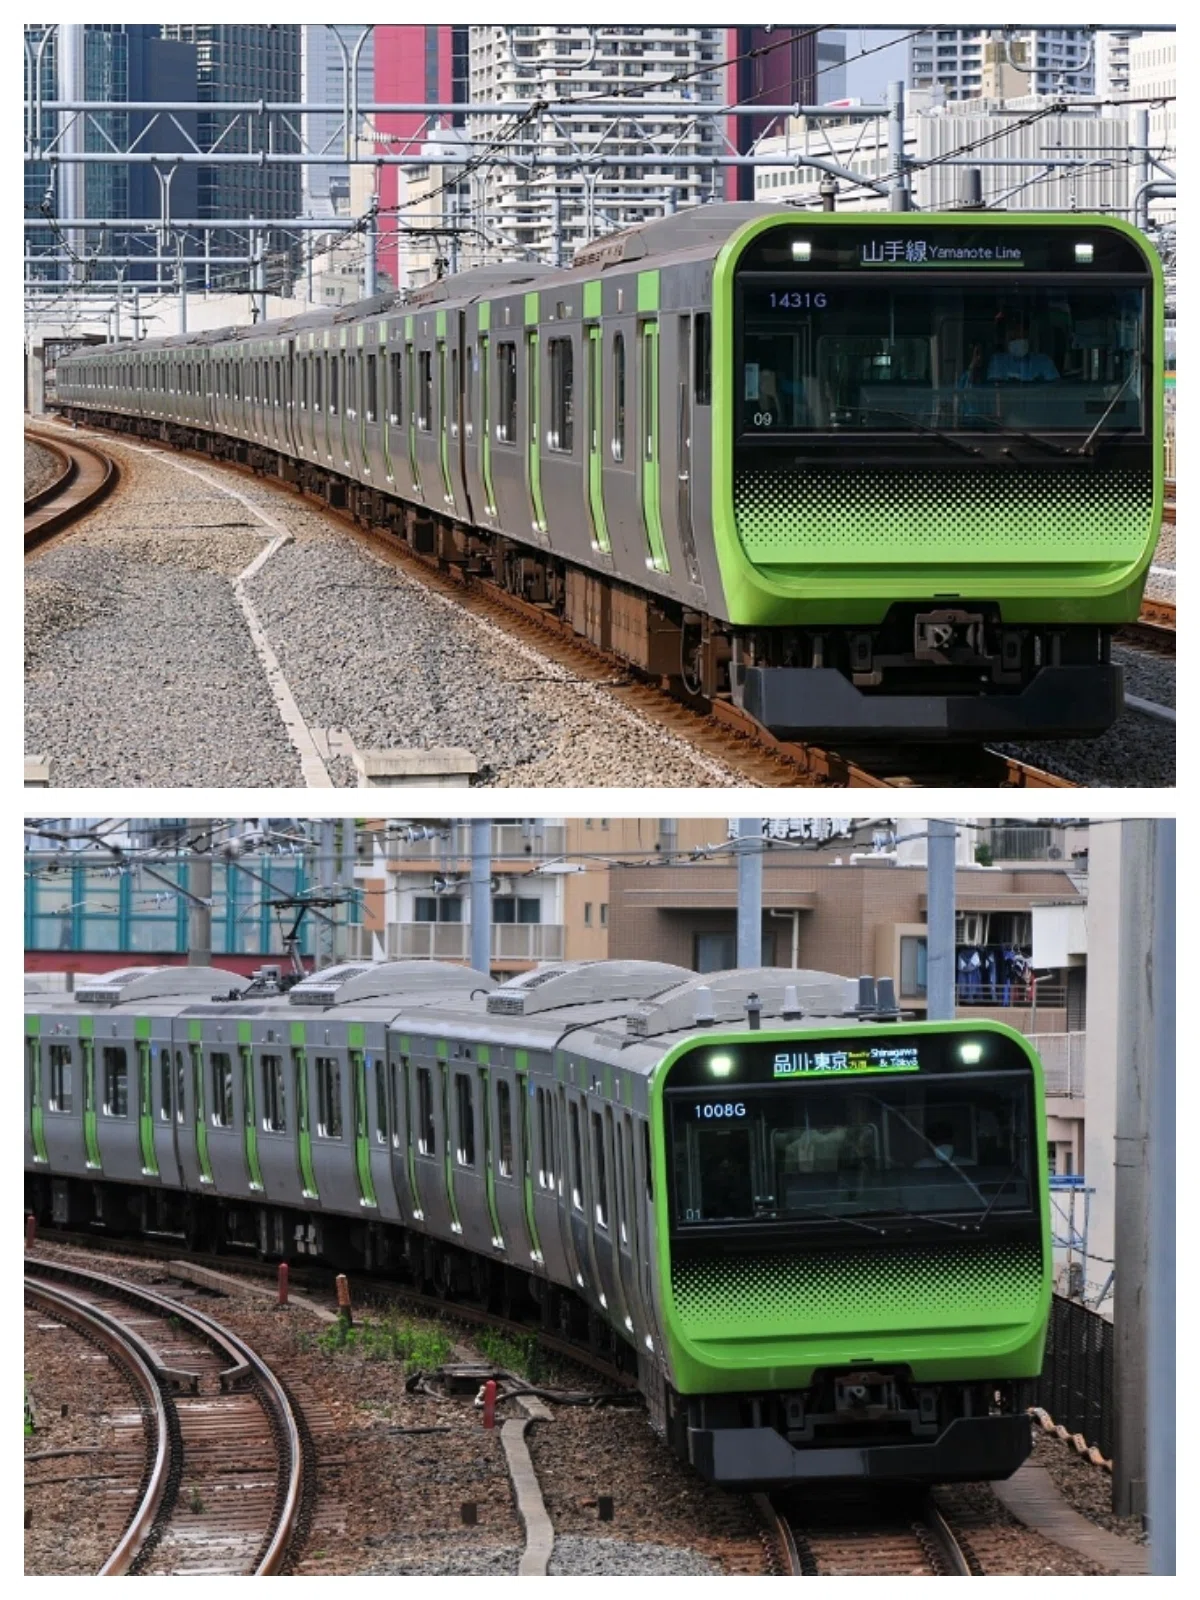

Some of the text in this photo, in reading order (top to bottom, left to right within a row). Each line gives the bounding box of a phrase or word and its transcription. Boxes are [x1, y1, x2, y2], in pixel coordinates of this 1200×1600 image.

[863, 240, 1021, 262] 山手線 Yamanote Line
[769, 292, 827, 308] 1431G
[753, 412, 772, 426] 09
[694, 1103, 746, 1118] 1008G
